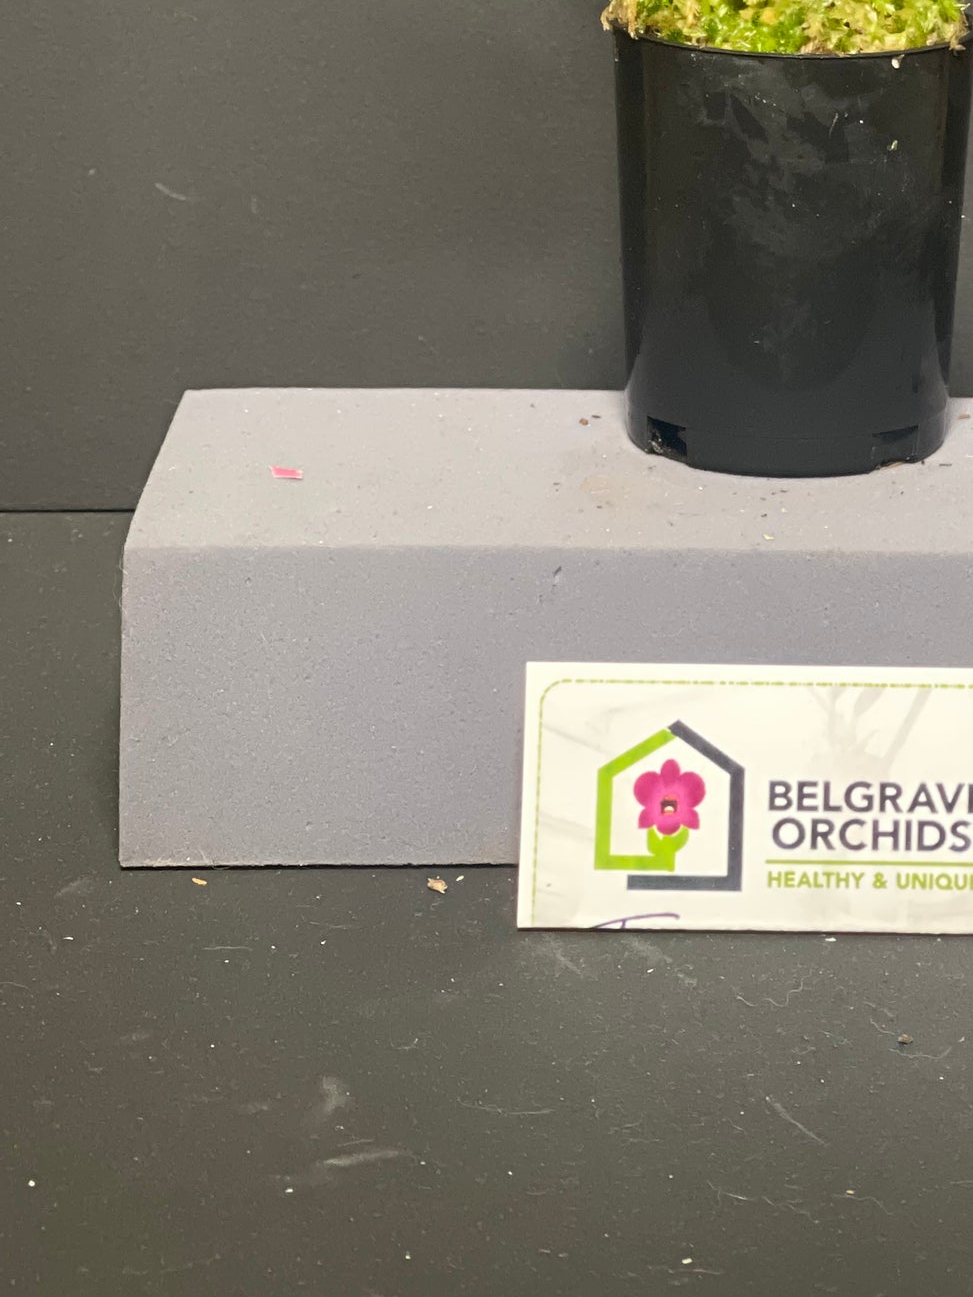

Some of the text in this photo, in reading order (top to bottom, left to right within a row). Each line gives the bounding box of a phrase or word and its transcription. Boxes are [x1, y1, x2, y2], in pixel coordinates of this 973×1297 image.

[771, 818, 972, 853] ORCHIDS
[766, 870, 863, 890] HEALTHY
[872, 872, 888, 890] &
